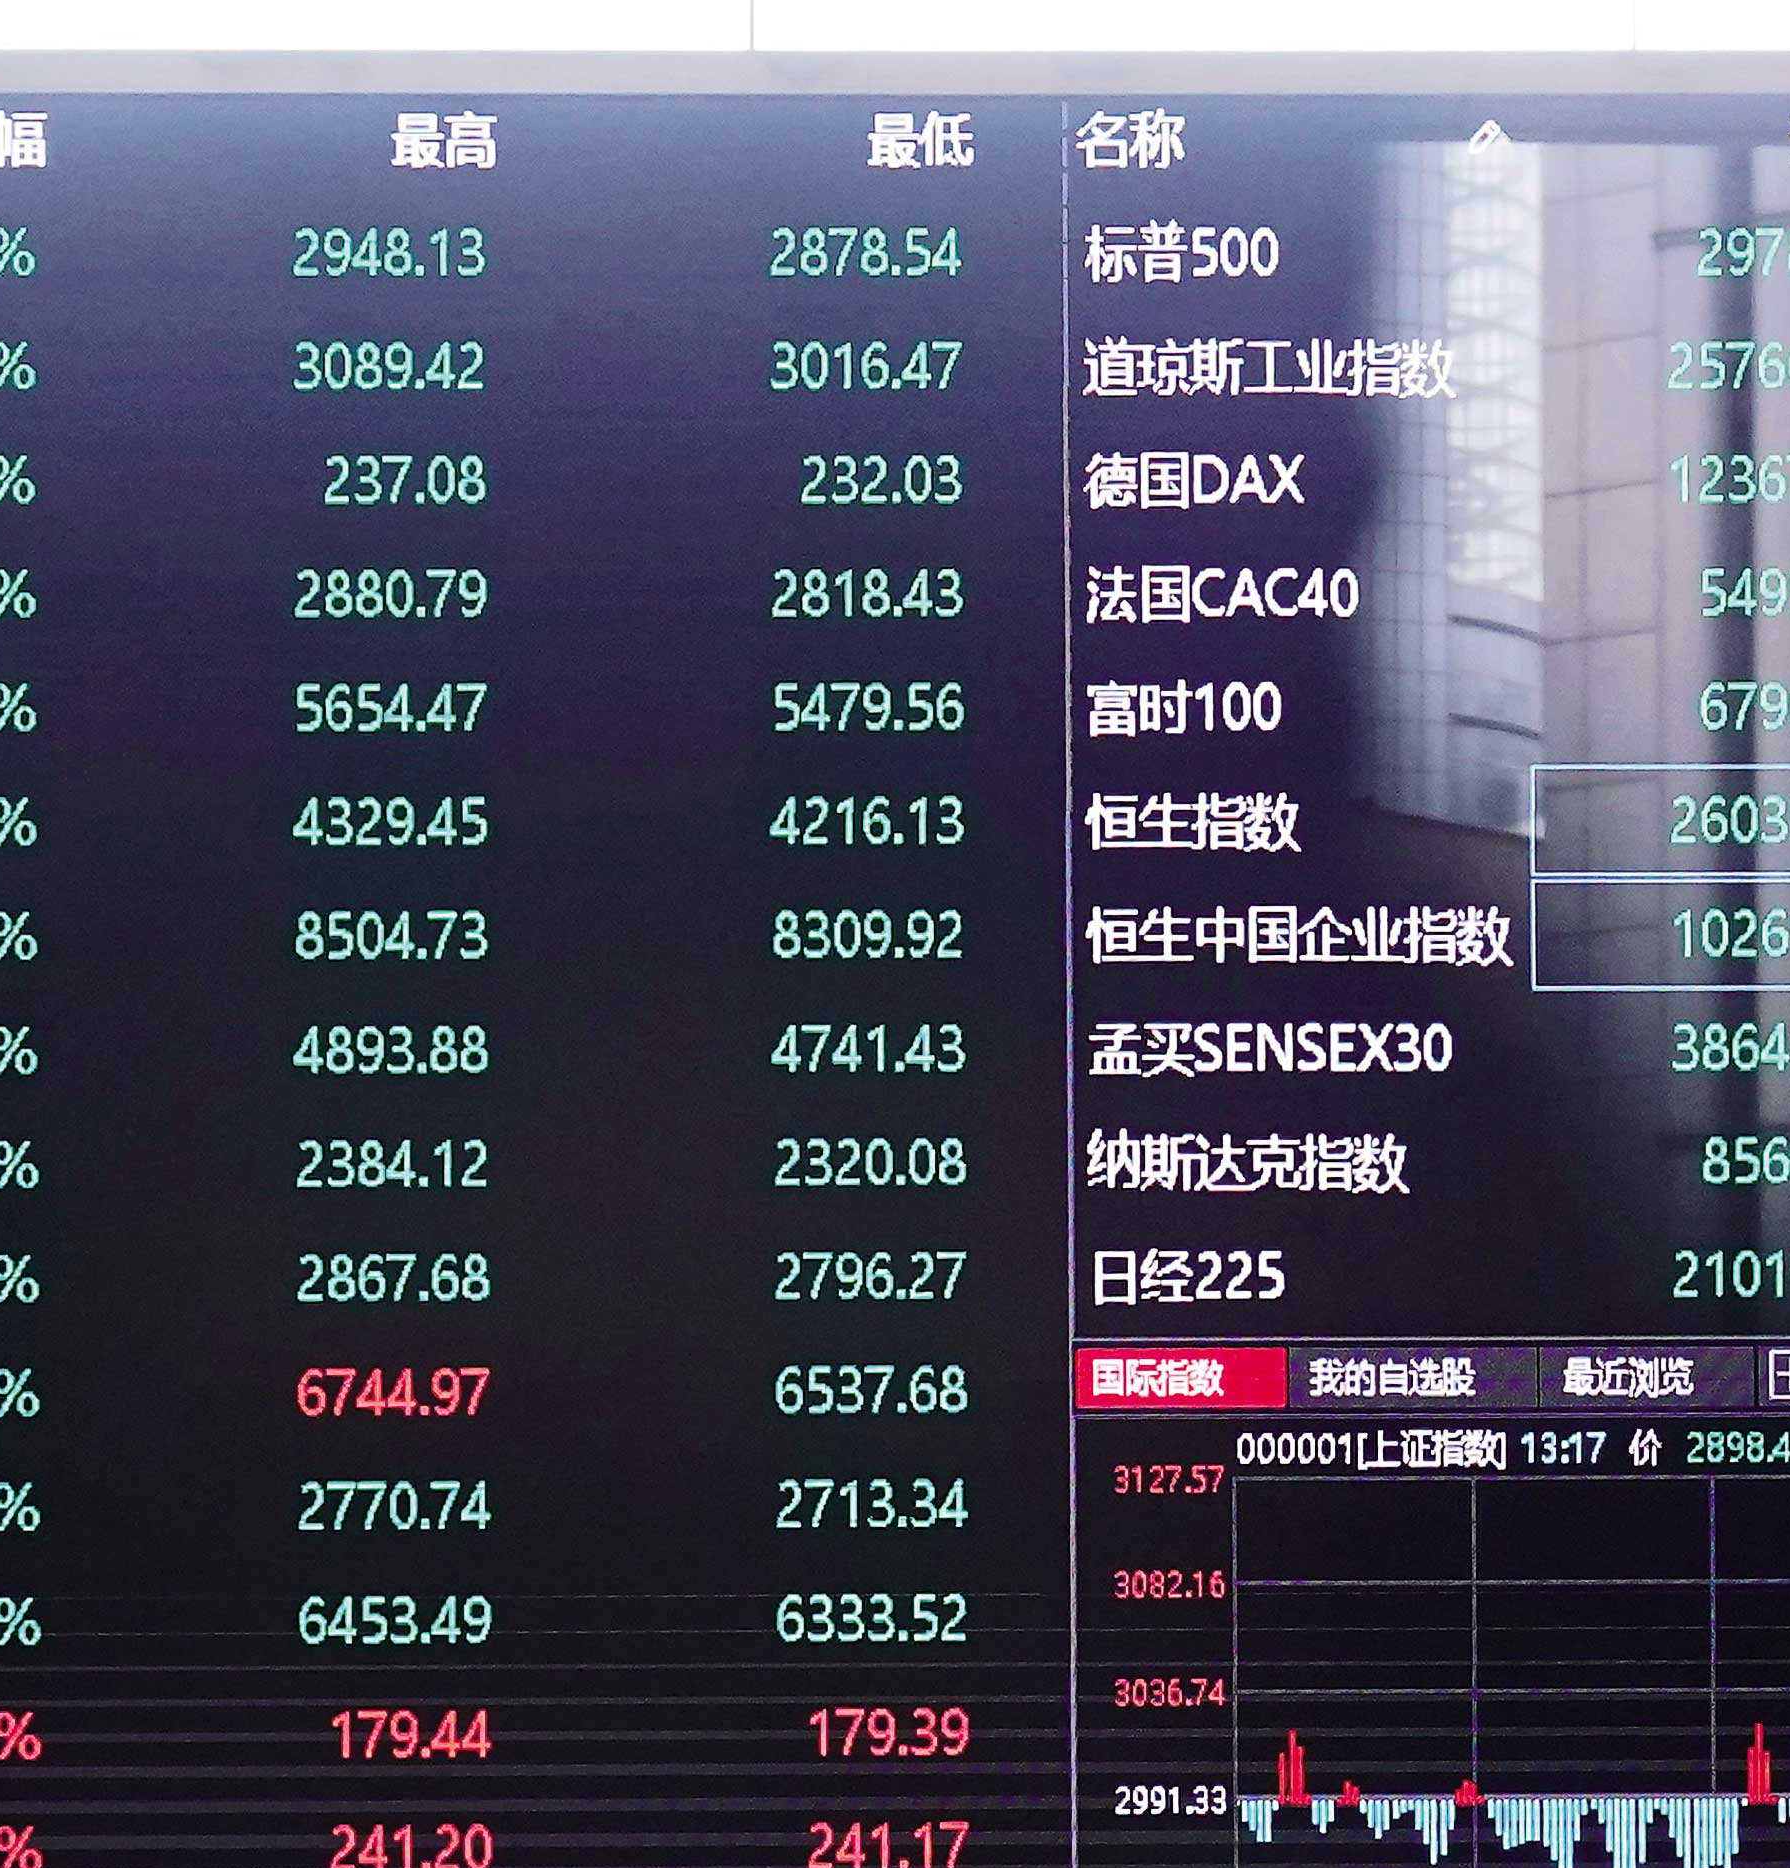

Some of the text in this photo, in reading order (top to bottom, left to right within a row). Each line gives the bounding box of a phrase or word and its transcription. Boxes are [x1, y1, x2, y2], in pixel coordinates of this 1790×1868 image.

[391, 111, 497, 168] 最高
[867, 111, 974, 168] 最低
[1076, 109, 1185, 168] 名称
[293, 228, 485, 276] 2948.13
[771, 227, 961, 276] 2878.54
[1083, 336, 1455, 398] 道琼斯工业指数
[325, 455, 485, 504] 237.08
[801, 455, 962, 504] 232.03
[1083, 452, 1304, 509] 德国DAX
[297, 683, 487, 732] 5654.47
[775, 682, 964, 731] 5479.56
[1087, 679, 1282, 737] 富时100
[1085, 792, 1301, 852] 恒生指数
[296, 910, 488, 960] 8504.73
[773, 909, 962, 958] 8309.92
[1085, 906, 1514, 966] 恒生中国企业指数
[1089, 1022, 1452, 1077] 孟买SENSEX30
[297, 1139, 486, 1187] 2384.12
[775, 1138, 966, 1186] 2320.08
[1095, 1248, 1285, 1305] 日经225
[297, 1367, 490, 1417] 6744.97
[776, 1365, 967, 1414] 6537.68
[1088, 1356, 1224, 1400] 国际指数
[1310, 1357, 1476, 1397] 我的自选股
[1563, 1356, 1694, 1397] 最近浏览
[1521, 1432, 1606, 1464] 13:17
[1629, 1429, 1662, 1466] 价
[1115, 1465, 1224, 1493] 3127.57
[1114, 1570, 1225, 1599] 3082.16
[299, 1596, 492, 1644] 6453.49
[777, 1593, 966, 1642] 6333.52
[1115, 1678, 1226, 1707] 3036.74
[1115, 1785, 1226, 1815] 2991.33
